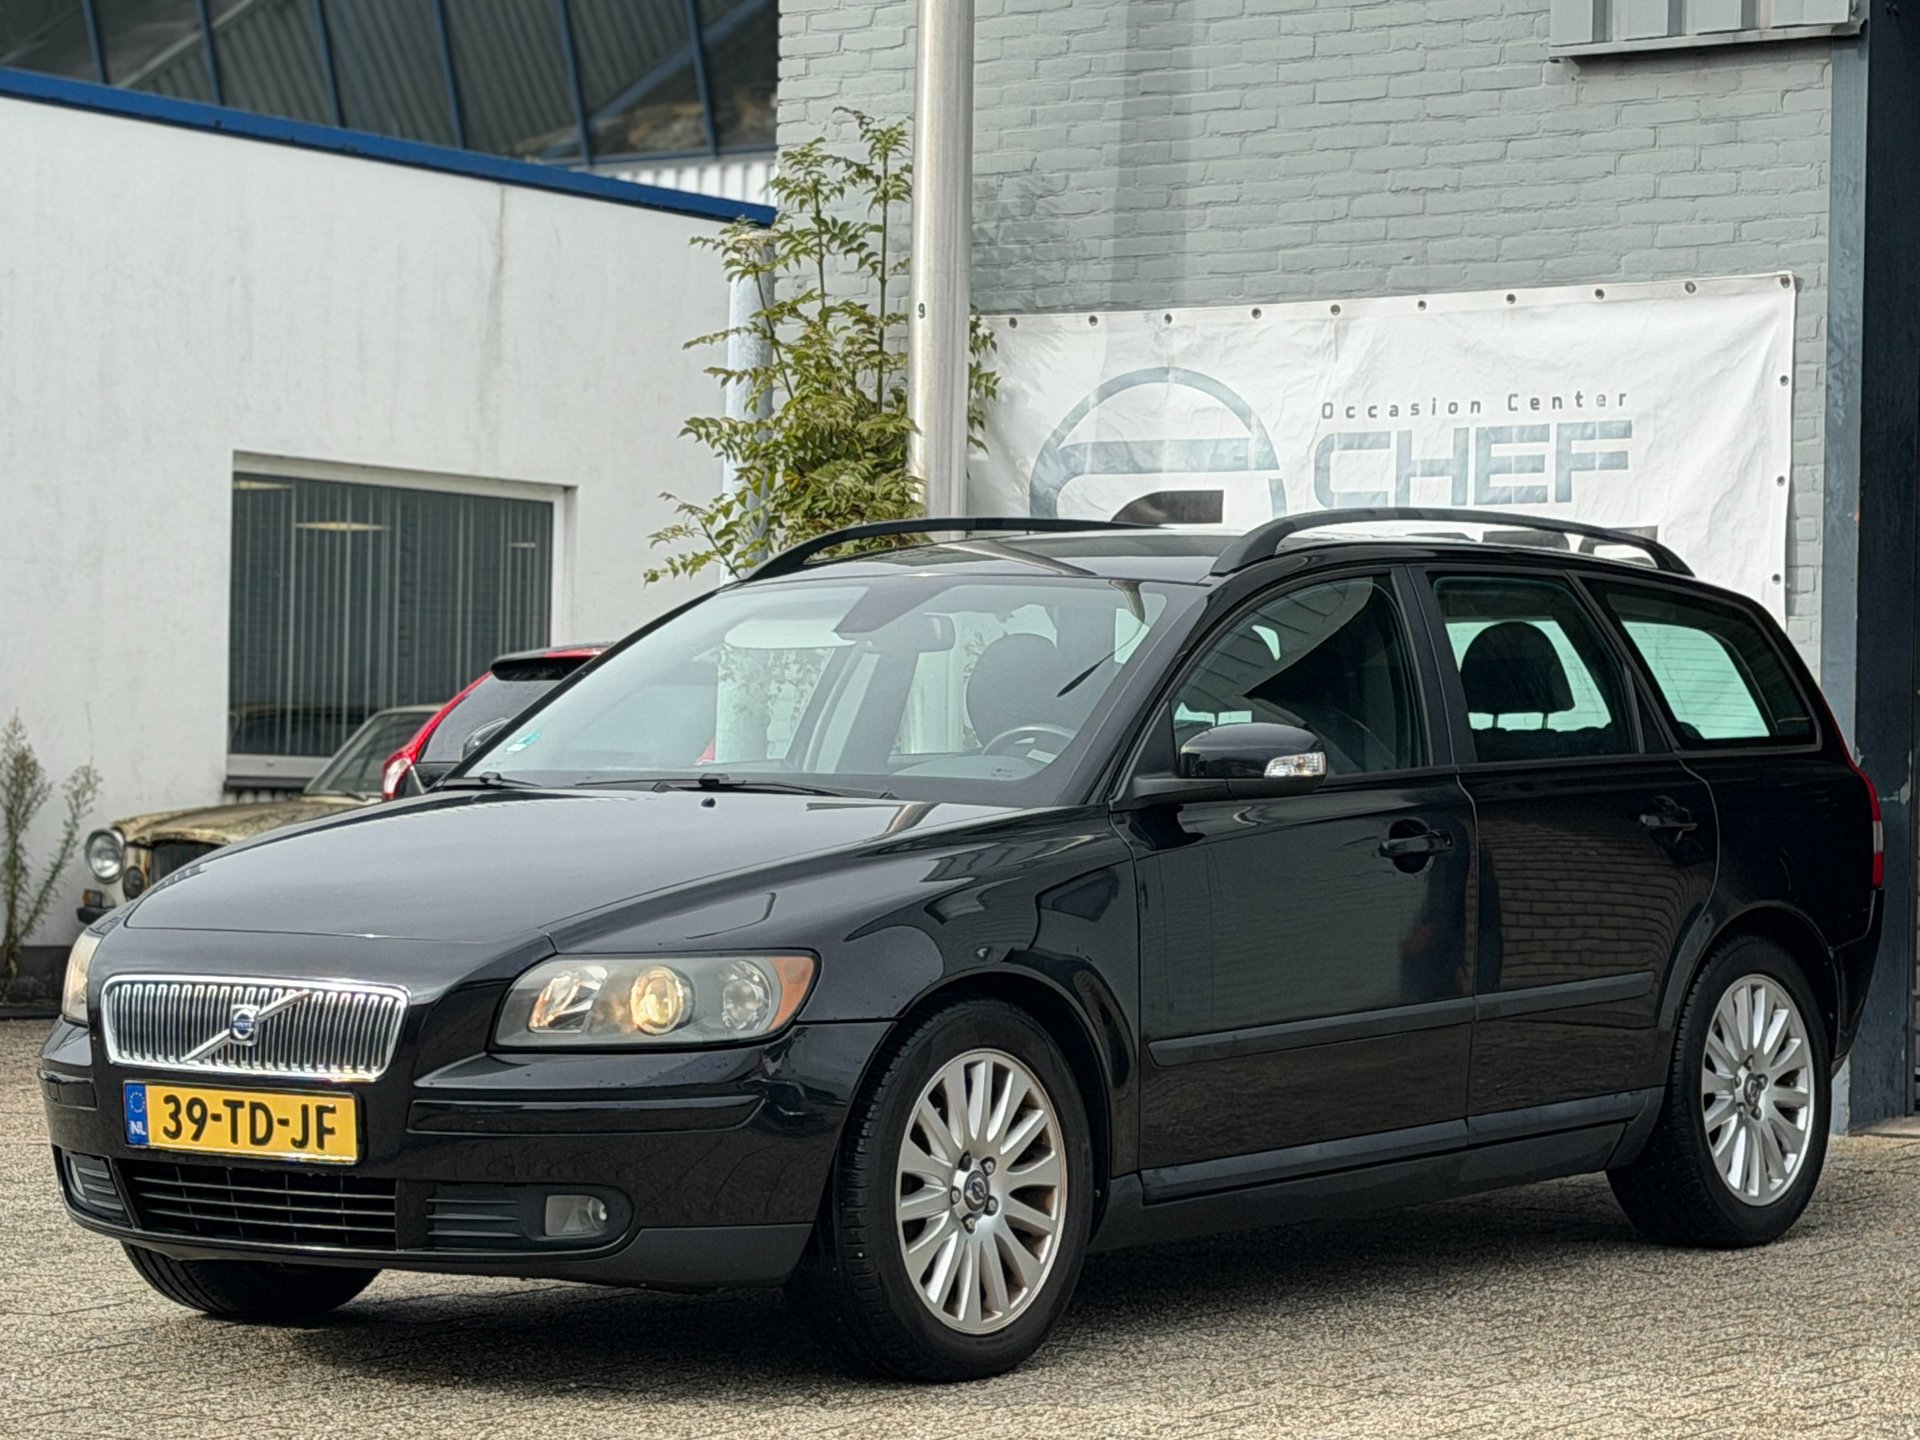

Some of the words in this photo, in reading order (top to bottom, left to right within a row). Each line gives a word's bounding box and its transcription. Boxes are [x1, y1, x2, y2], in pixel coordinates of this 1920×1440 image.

[1321, 397, 1481, 420] Occasion
[1507, 390, 1627, 411] Center
[1313, 419, 1633, 508] CHEF
[129, 1120, 147, 1136] NL
[161, 1094, 337, 1150] 39-TD-JF
